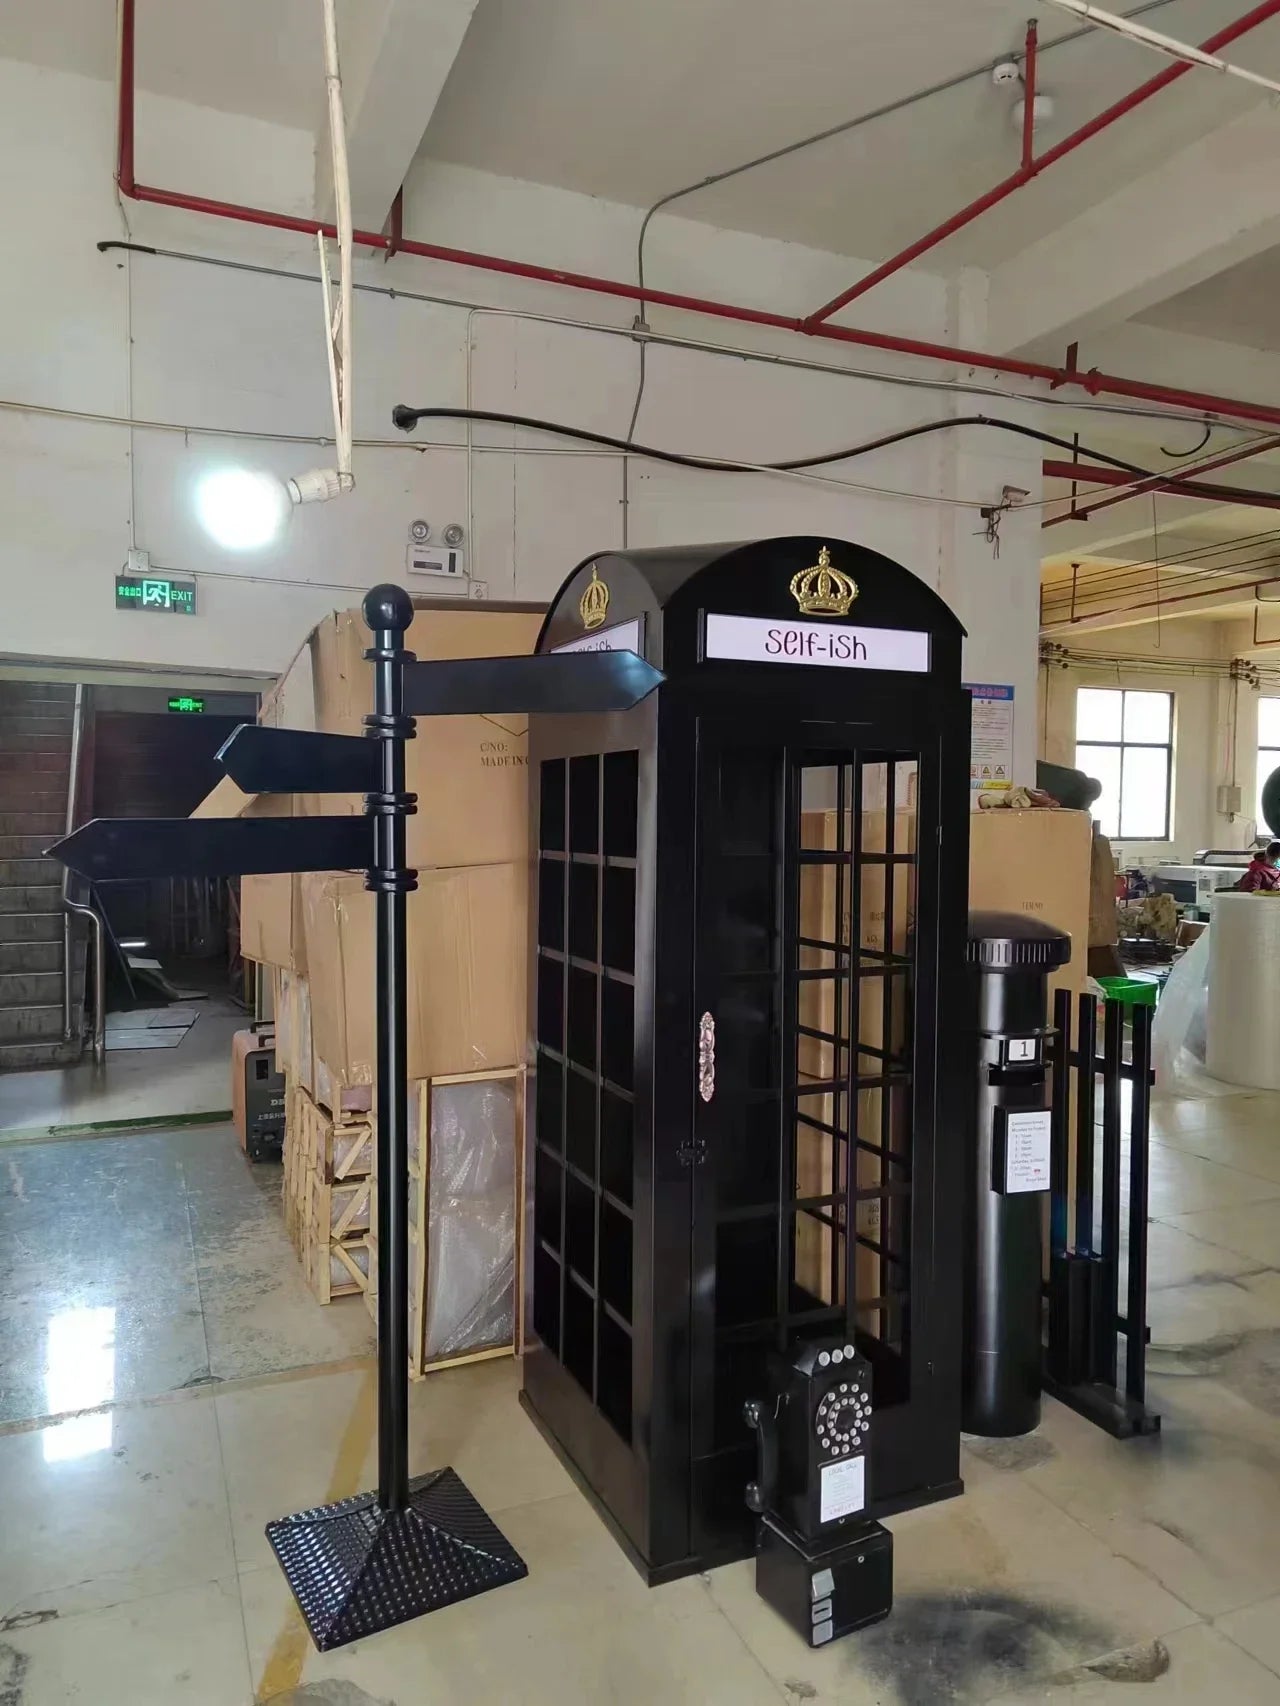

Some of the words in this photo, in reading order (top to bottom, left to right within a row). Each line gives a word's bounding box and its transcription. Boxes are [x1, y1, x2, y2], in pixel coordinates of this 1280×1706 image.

[118, 586, 142, 597] 安全出口
[170, 590, 193, 602] EXIT
[512, 755, 522, 766] IN
[1020, 1040, 1029, 1057] 1
